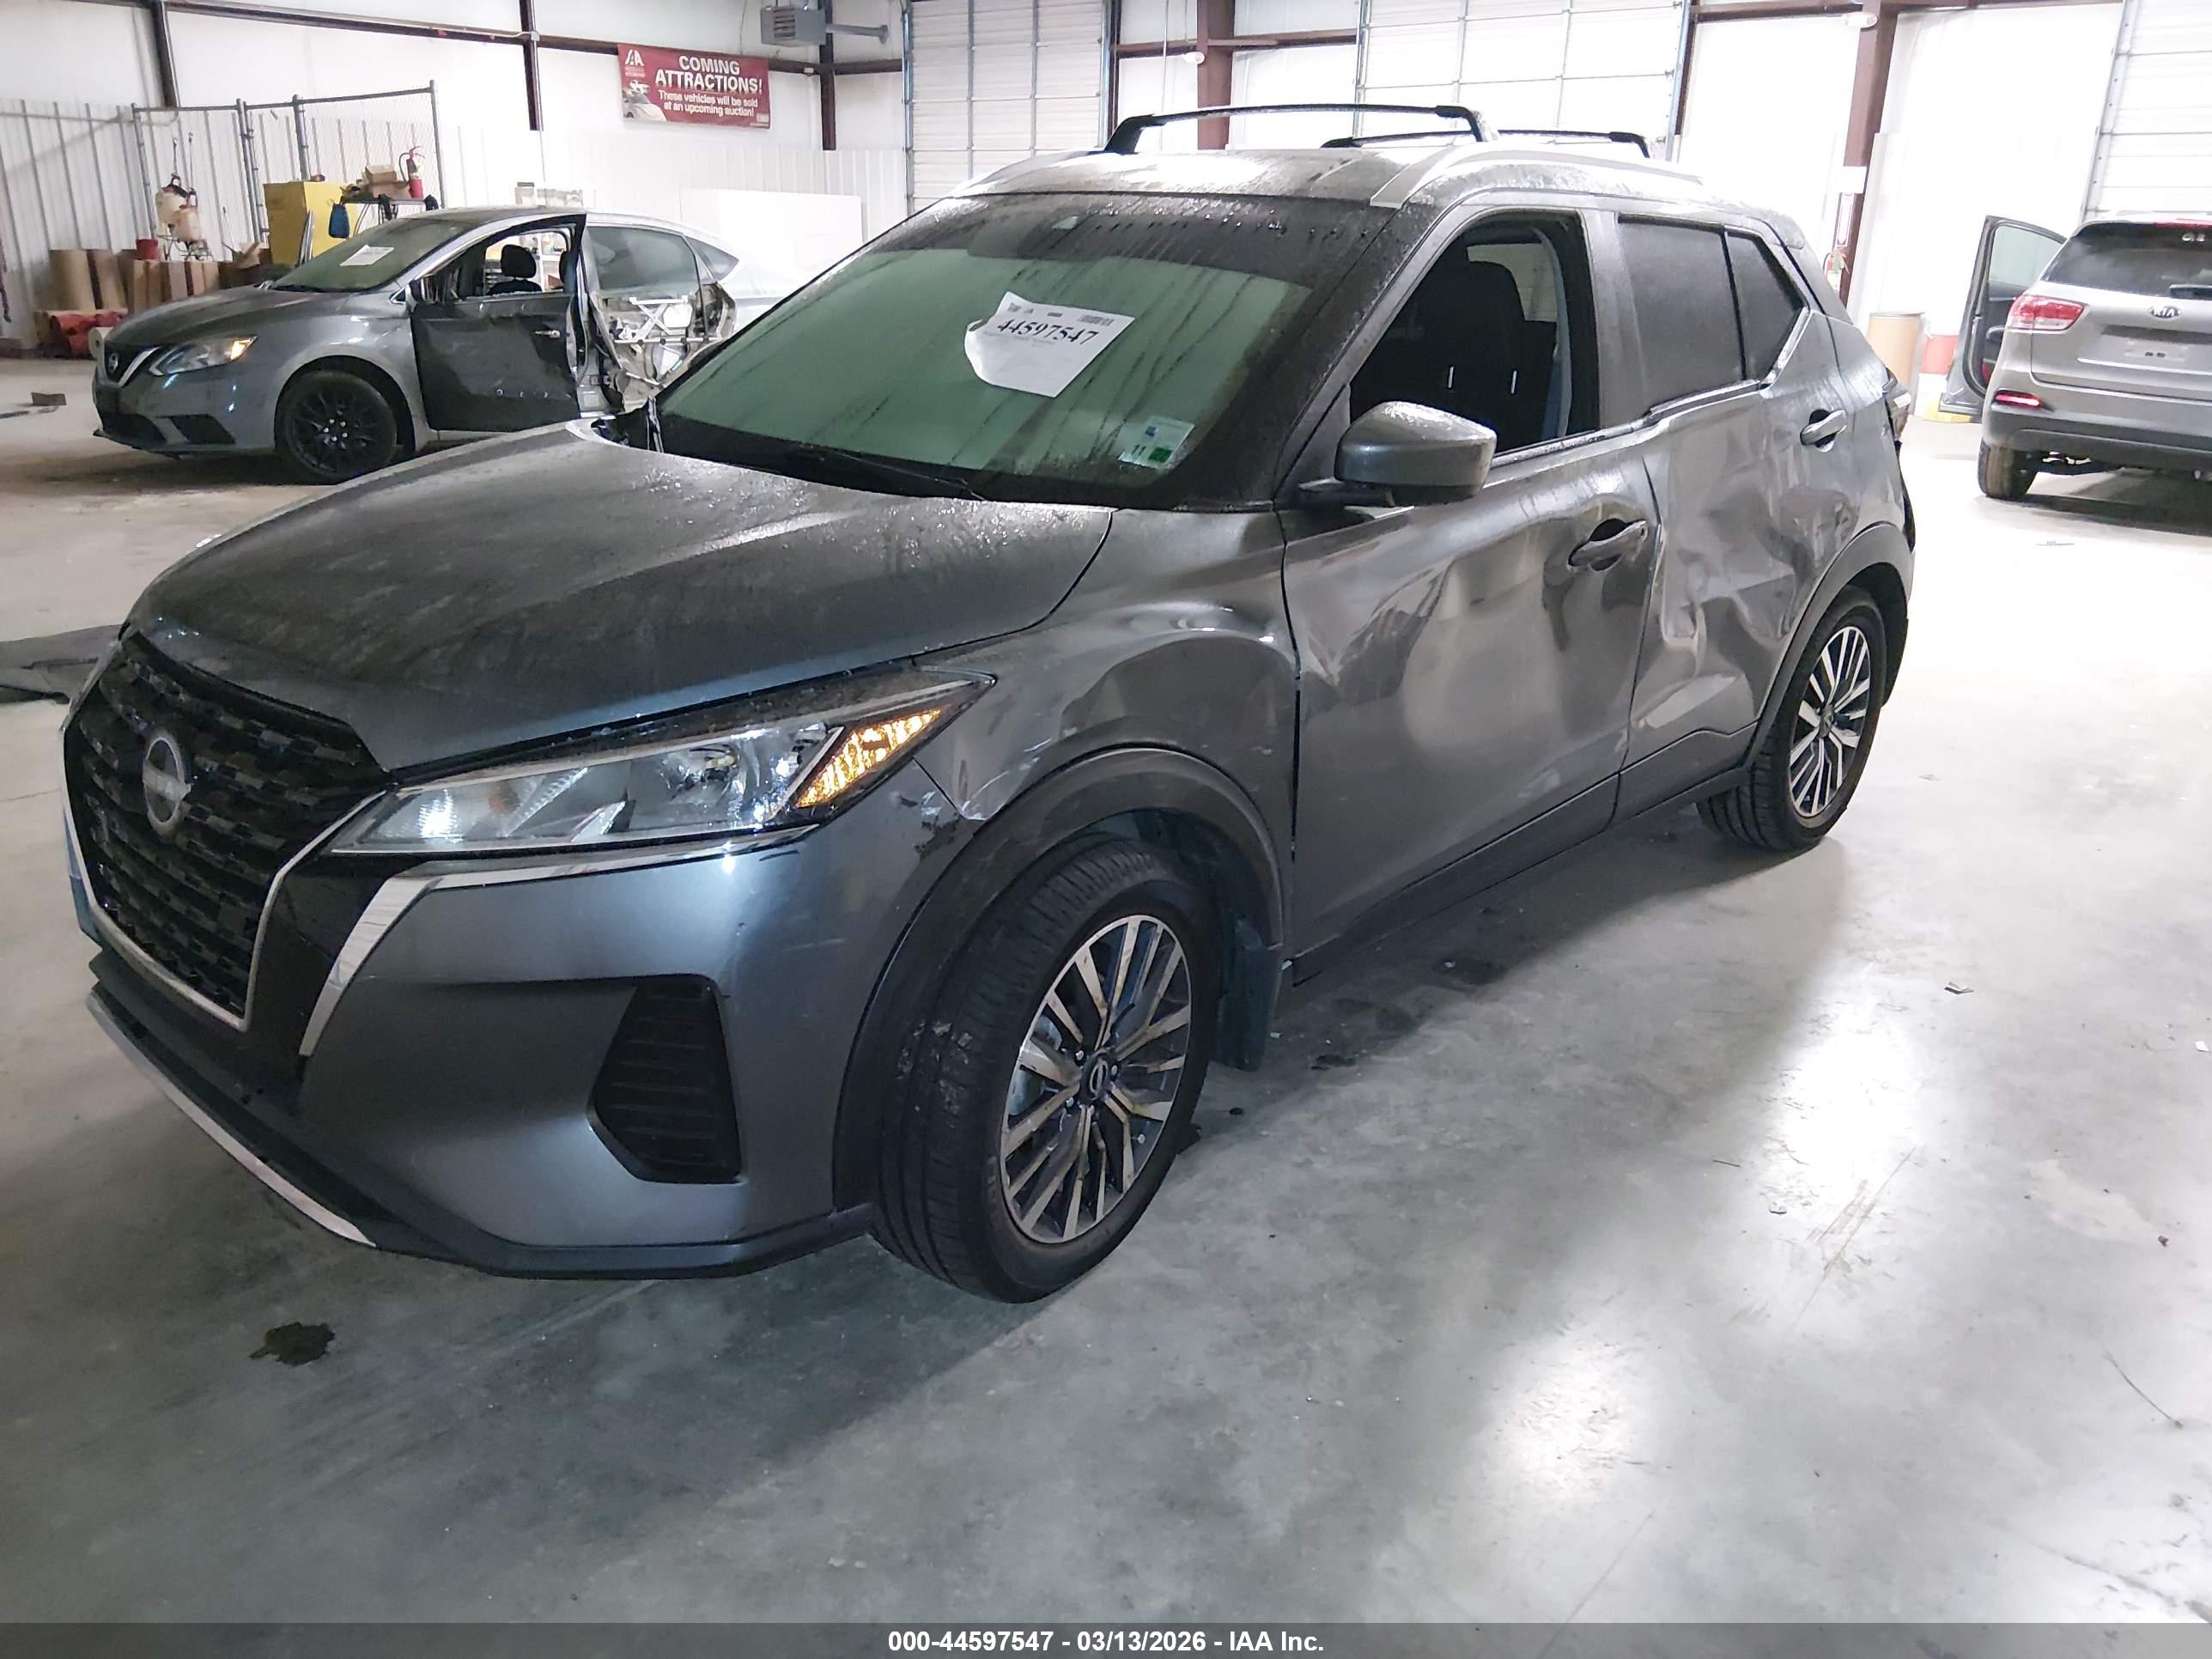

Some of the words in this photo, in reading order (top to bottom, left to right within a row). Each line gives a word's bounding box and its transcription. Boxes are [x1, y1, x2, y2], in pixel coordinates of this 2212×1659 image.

[678, 55, 740, 76] COMING
[655, 69, 763, 94] ATTRACTIONS!
[658, 89, 683, 101] These
[684, 93, 715, 104] vehicles
[717, 95, 730, 106] will
[732, 96, 742, 106] be
[744, 98, 758, 108] sold
[664, 101, 672, 110] at
[673, 102, 684, 112] an
[684, 103, 724, 117] upcoming
[724, 106, 755, 118] auction!
[2151, 307, 2175, 317] KIA
[997, 319, 1099, 344] 44597547
